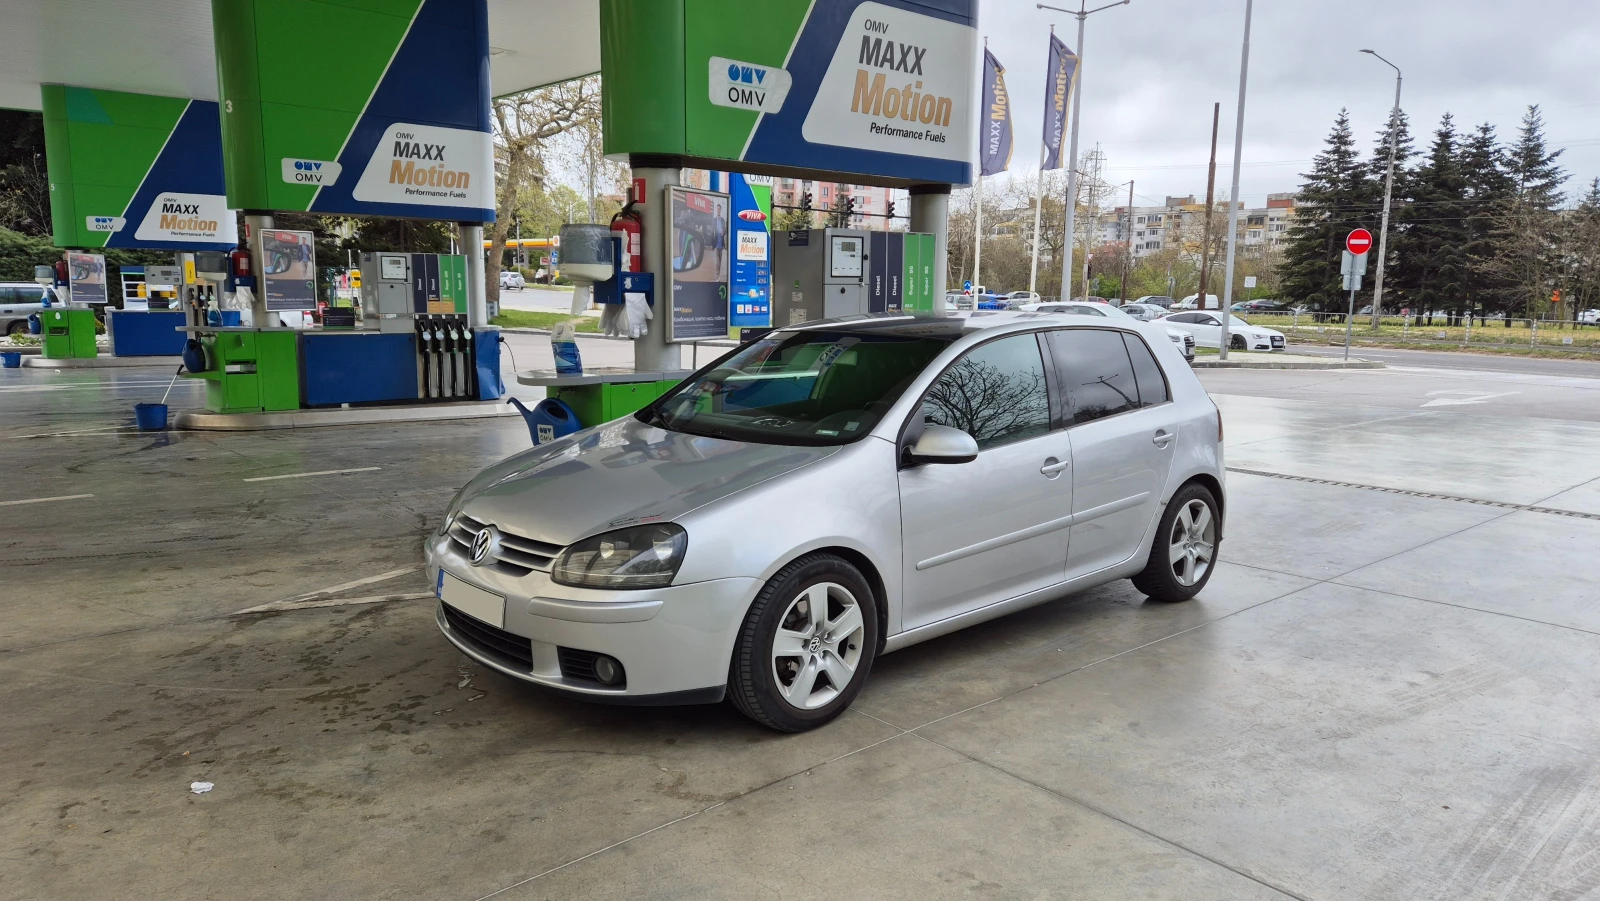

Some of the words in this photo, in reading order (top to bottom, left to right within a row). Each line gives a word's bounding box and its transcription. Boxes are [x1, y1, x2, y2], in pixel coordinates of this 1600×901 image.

[864, 19, 889, 34] OMV
[858, 35, 927, 76] MAXX
[728, 87, 766, 107] OMV
[851, 69, 953, 127] Motion
[225, 100, 233, 113] 3
[395, 132, 415, 140] OMV
[869, 122, 923, 141] Performance
[925, 130, 946, 143] Fuels
[1053, 112, 1062, 148] MAXX
[989, 121, 1000, 155] MAXX
[393, 141, 446, 162] MAXX
[295, 173, 323, 183] OMV
[389, 160, 470, 189] Motion
[750, 175, 770, 183] OMV
[50, 183, 55, 191] 5
[405, 188, 448, 198] Performance
[449, 191, 467, 199] Fuels
[162, 203, 200, 215] MAXX
[745, 212, 762, 220] VIVA
[159, 214, 218, 232] Motion
[740, 244, 765, 255] Motion
[908, 265, 914, 274] 95
